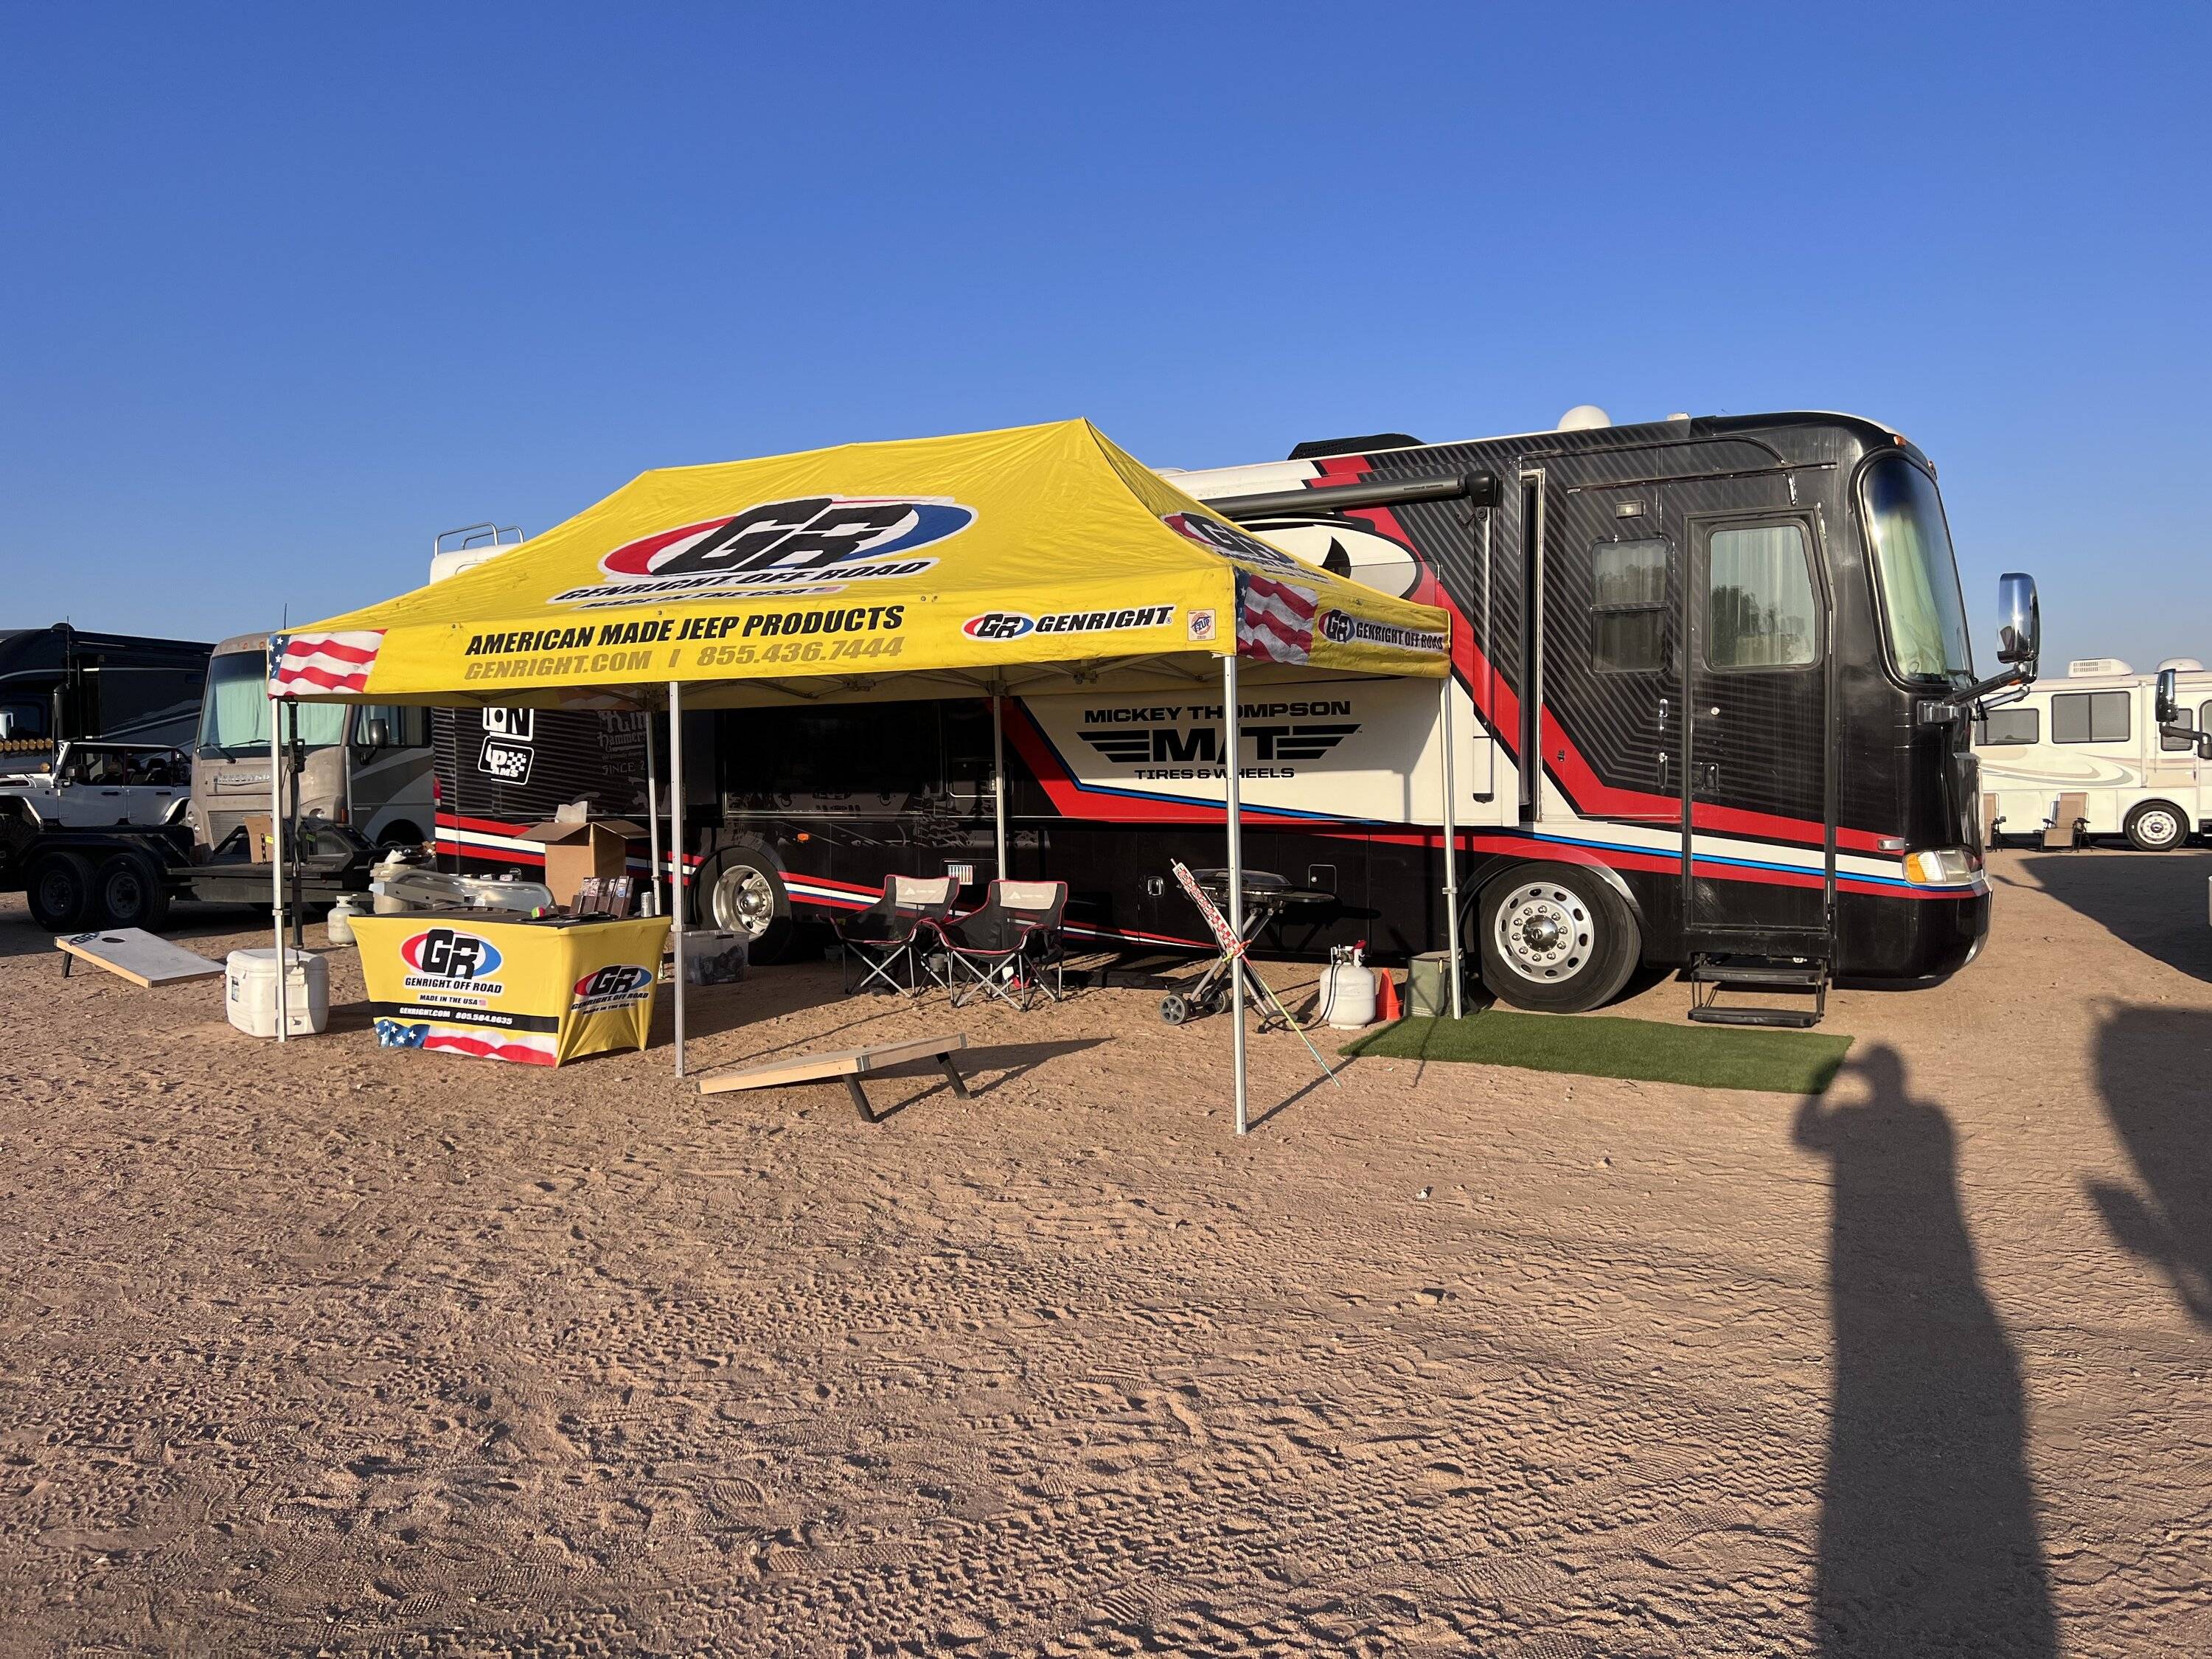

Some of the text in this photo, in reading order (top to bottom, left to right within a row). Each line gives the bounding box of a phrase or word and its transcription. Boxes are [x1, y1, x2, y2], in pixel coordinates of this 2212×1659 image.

[651, 498, 913, 575] GR
[554, 562, 931, 600] GENRIGHT OFF ROAD
[465, 605, 905, 655] AMERICAN MADE JEEP PRODUCTS
[976, 613, 1022, 639] GR
[1326, 609, 1444, 650] GR GENRIGHT OFF ROAD
[465, 650, 653, 680] GENRIGHT.COM
[697, 636, 906, 667] 855.436.7444
[1085, 700, 1352, 723] MICKEY THMPSON
[1134, 769, 1194, 780] TIRES
[1197, 768, 1212, 779] &
[422, 929, 480, 980] GR
[406, 977, 502, 994] GENRIGHT OFF ROAD
[589, 965, 639, 995] GR
[399, 1007, 451, 1018] GENRIGHT.COM
[571, 995, 612, 1010] GENRIGHT
[613, 993, 627, 1001] OFF
